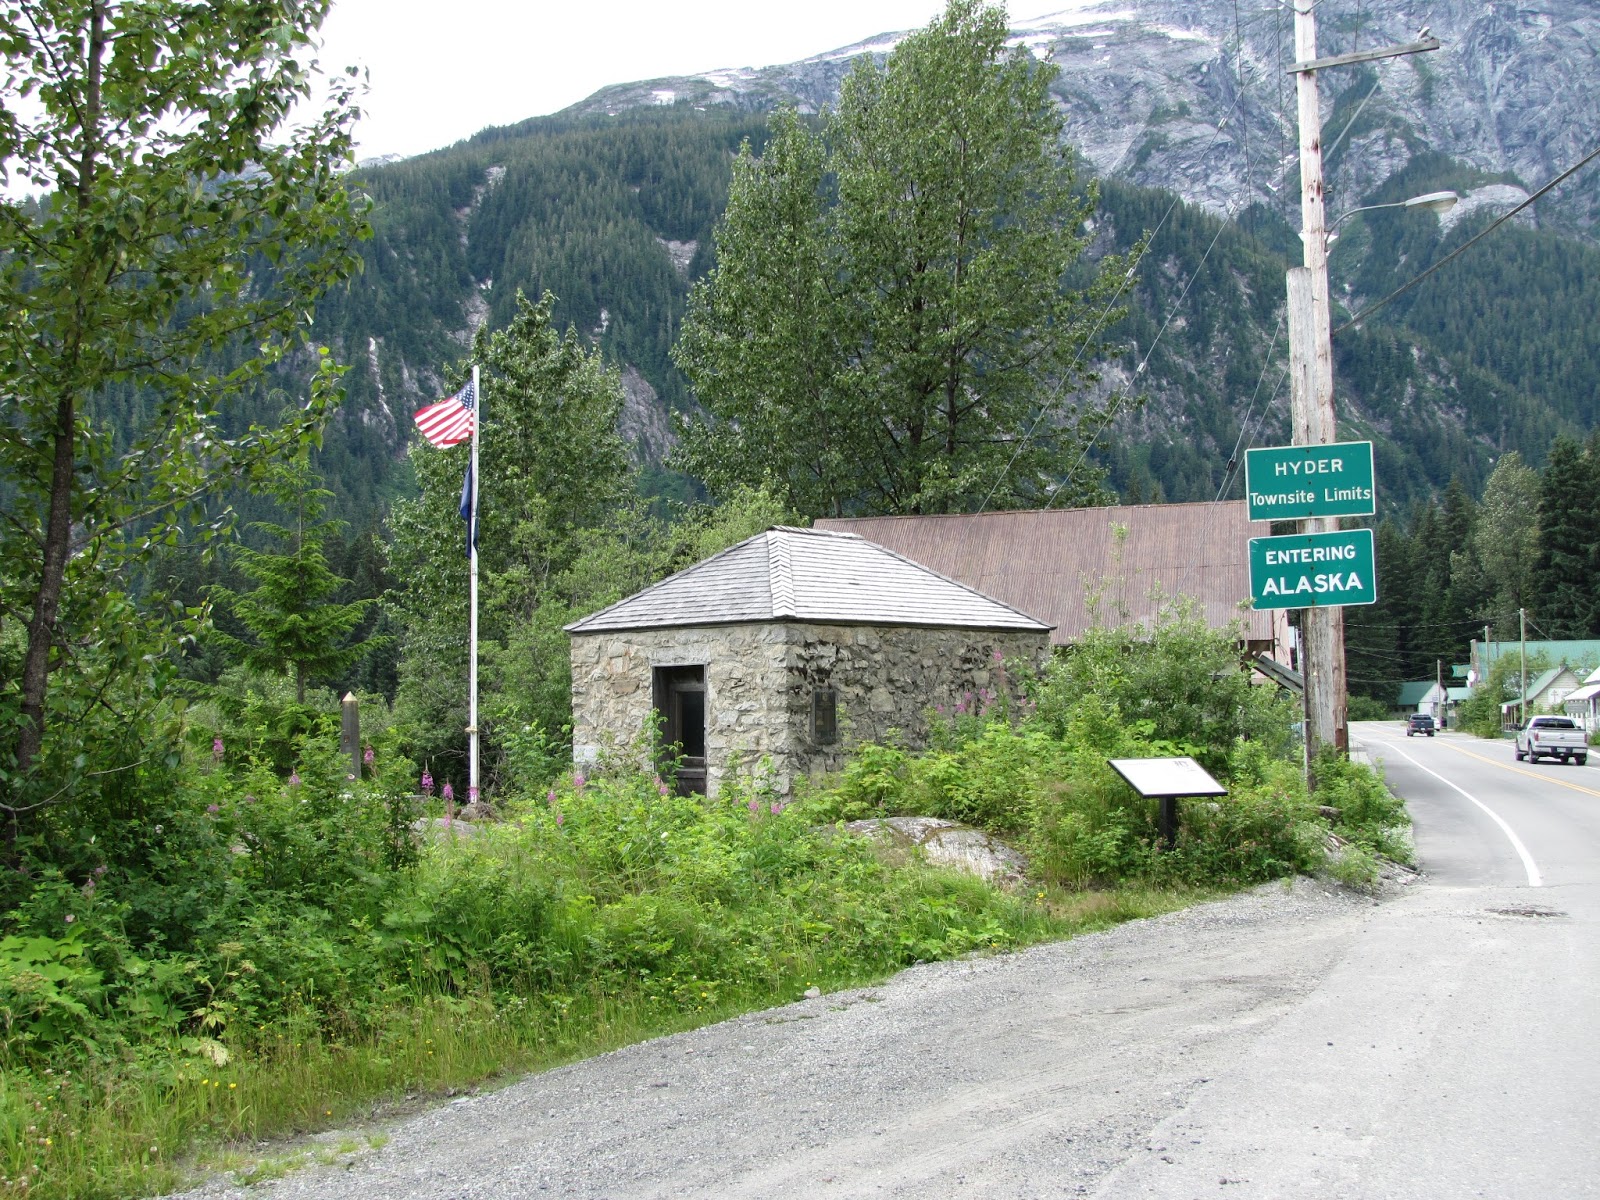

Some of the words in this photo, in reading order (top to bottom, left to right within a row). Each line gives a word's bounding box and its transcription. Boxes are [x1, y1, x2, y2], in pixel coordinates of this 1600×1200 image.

[1275, 459, 1343, 476] HYDER
[1250, 490, 1315, 506] Townsite
[1324, 486, 1371, 502] Limits
[1265, 545, 1356, 565] ENTERING
[1262, 572, 1363, 596] ALASKA
